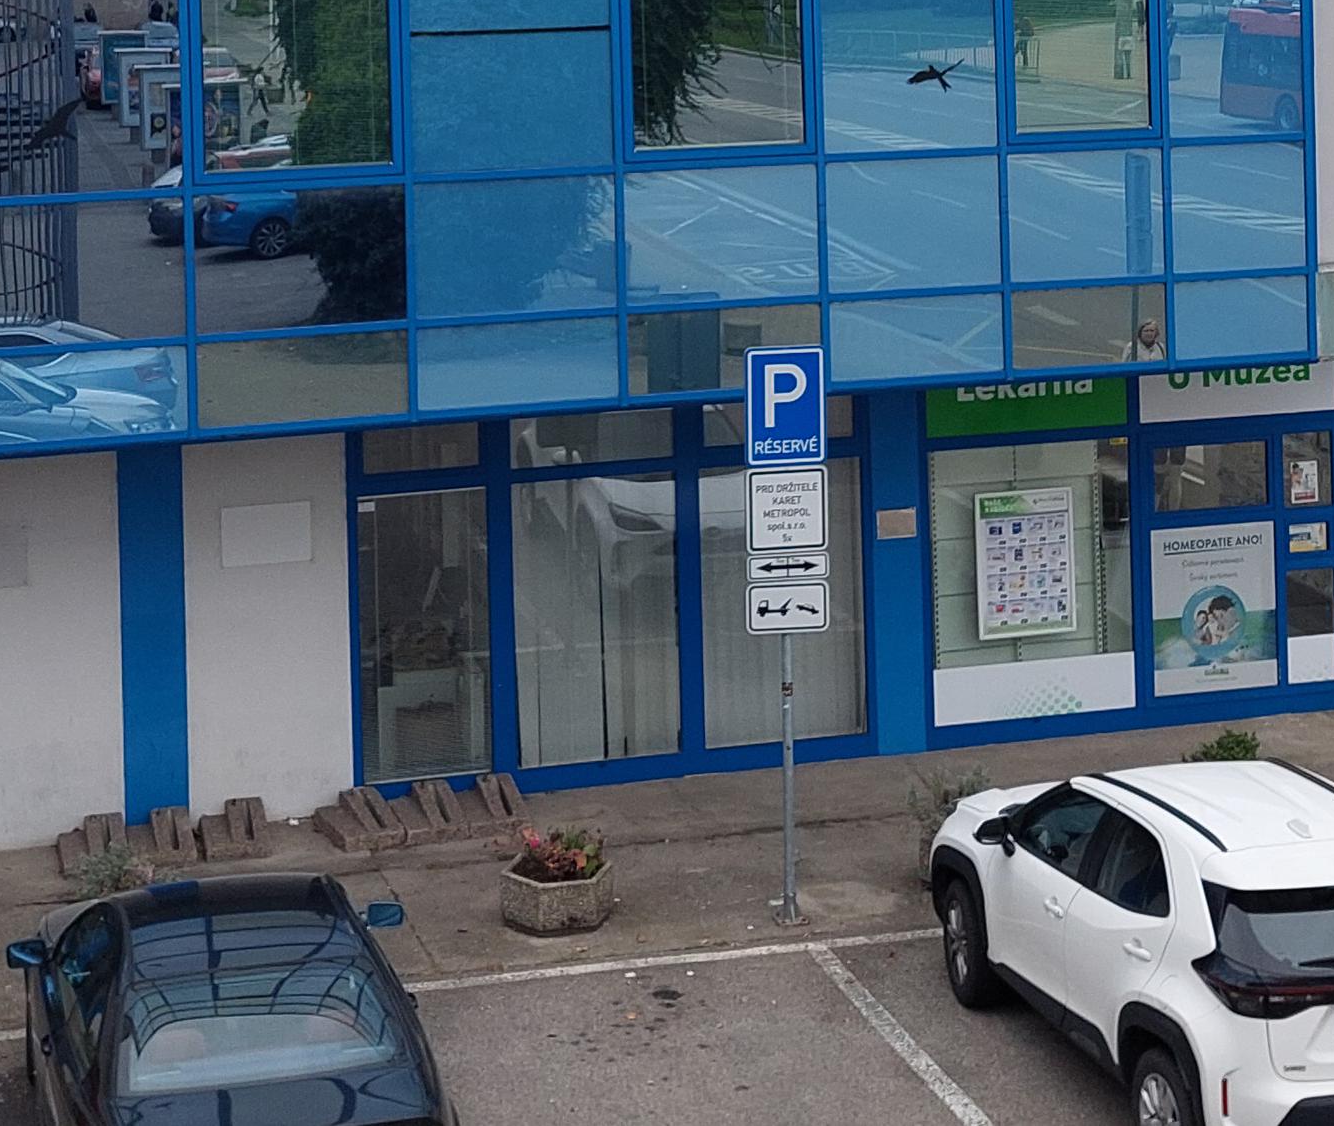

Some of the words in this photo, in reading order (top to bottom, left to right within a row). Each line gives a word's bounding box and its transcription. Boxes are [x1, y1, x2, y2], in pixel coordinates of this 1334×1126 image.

[1202, 363, 1311, 387] Muzea
[764, 363, 807, 428] P
[754, 435, 818, 455] RÉSERVÉ
[755, 484, 774, 494] PRO
[776, 481, 818, 494] DRŽITELE
[772, 495, 802, 505] KARET
[763, 508, 811, 519] METROPOL
[1163, 537, 1233, 553] HOMEOPATIE
[1235, 533, 1263, 545] ANO!
